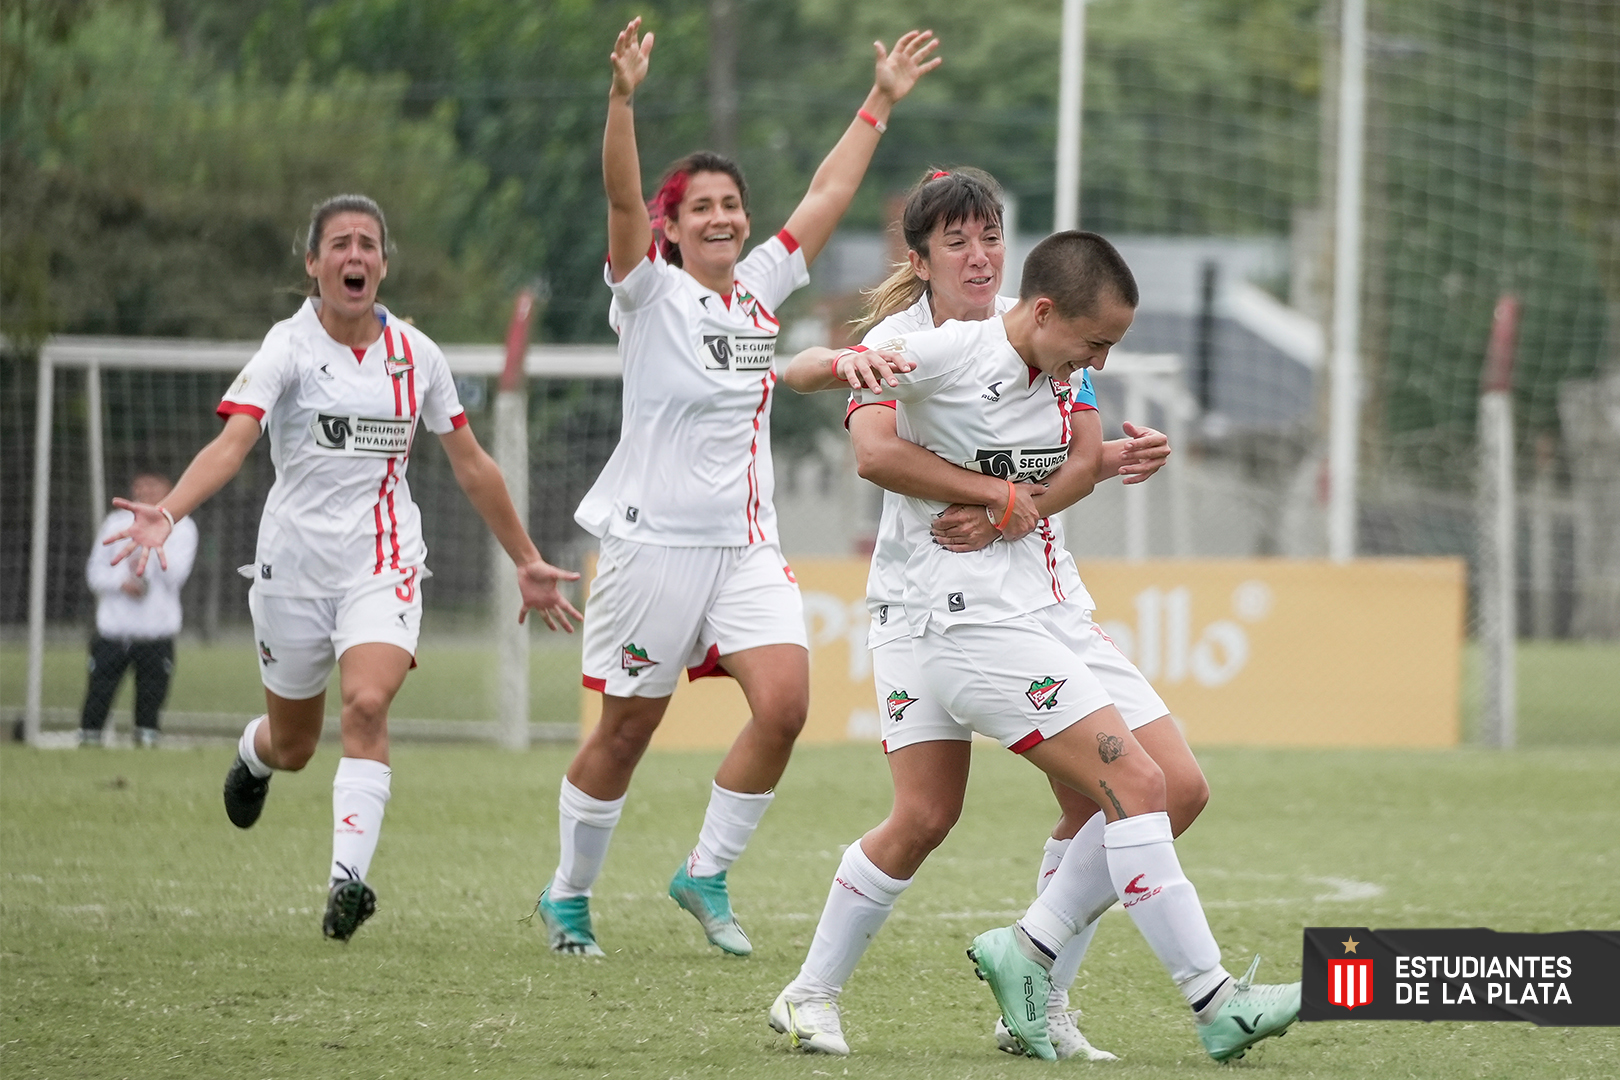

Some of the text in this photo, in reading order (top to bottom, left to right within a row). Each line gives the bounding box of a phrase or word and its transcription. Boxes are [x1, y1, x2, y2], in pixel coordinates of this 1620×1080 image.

[736, 343, 776, 352] SEGURO
[356, 424, 406, 435] SEGUROS
[355, 436, 408, 447] RIVADAVIA
[1019, 453, 1066, 468] SEGUROS
[395, 566, 417, 603] 3
[1023, 975, 1036, 1022] REVES
